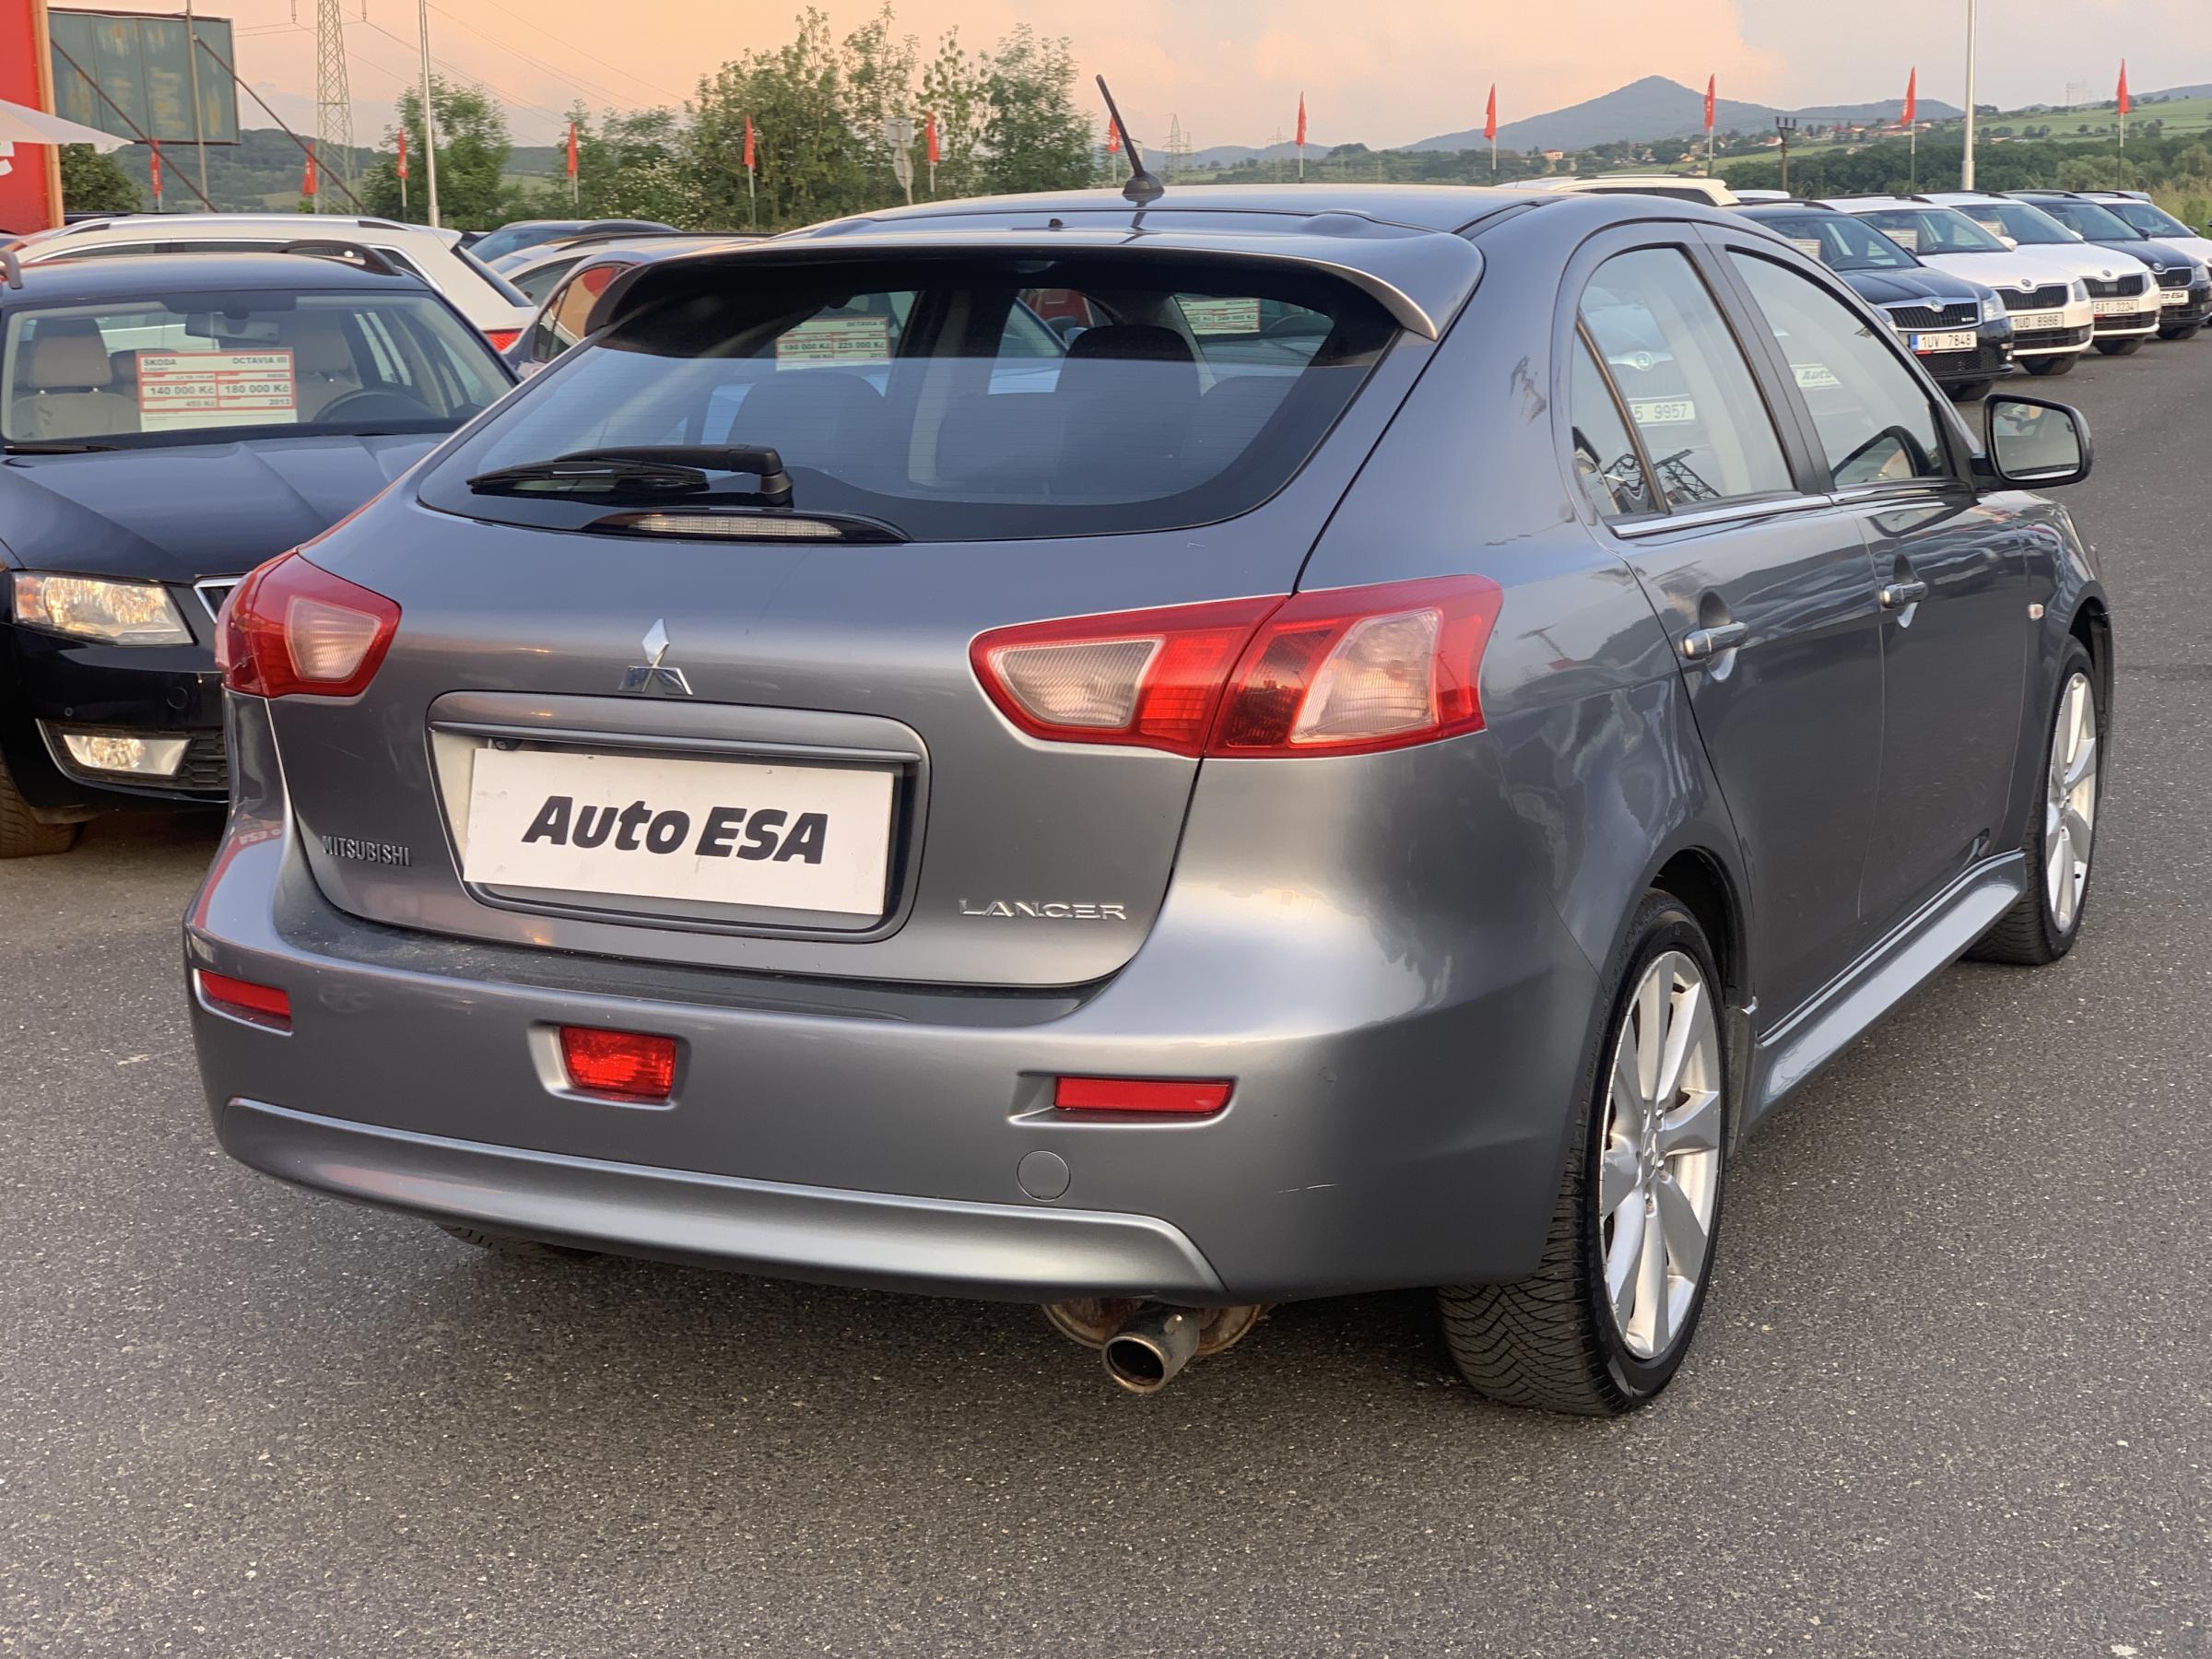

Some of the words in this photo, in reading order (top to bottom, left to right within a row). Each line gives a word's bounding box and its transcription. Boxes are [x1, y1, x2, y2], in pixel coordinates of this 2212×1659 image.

[1922, 335, 1940, 348] 1UV
[1947, 335, 1971, 347] 7848
[231, 357, 275, 365] OCTAVIA
[150, 386, 171, 395] 140
[173, 385, 196, 395] 000
[199, 384, 215, 394] Kč
[225, 384, 246, 394] 180
[249, 384, 271, 394] 000
[274, 383, 289, 393] Kč
[1653, 403, 1688, 419] 9957
[521, 795, 690, 854] Auto
[695, 806, 829, 865] ESA
[321, 834, 411, 866] MITSUBISHI
[958, 899, 1127, 920] LANCER
